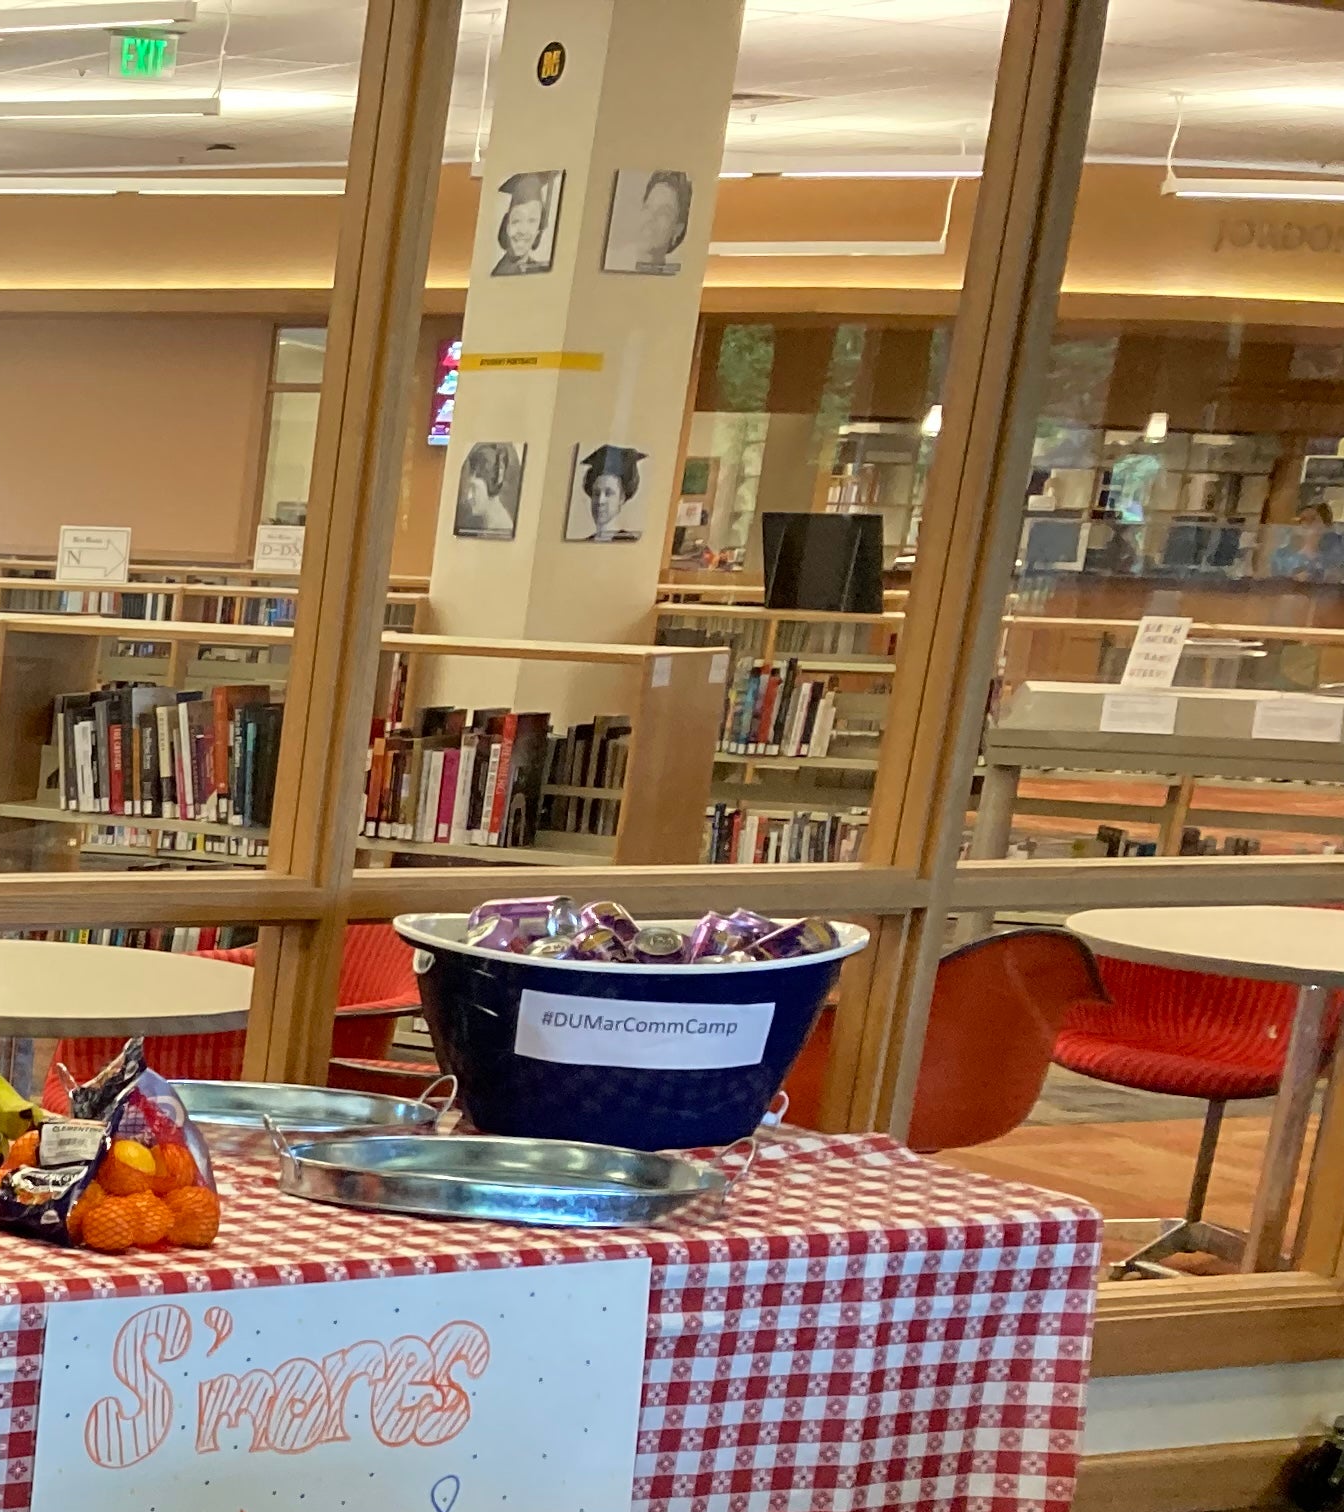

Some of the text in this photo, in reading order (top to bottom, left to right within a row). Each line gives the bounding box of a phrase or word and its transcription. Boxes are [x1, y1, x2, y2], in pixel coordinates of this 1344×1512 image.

[120, 37, 167, 77] EXIT
[66, 549, 83, 566] N
[541, 1010, 739, 1037] #DUMarCommCamp
[84, 1303, 491, 1470] S'mores
